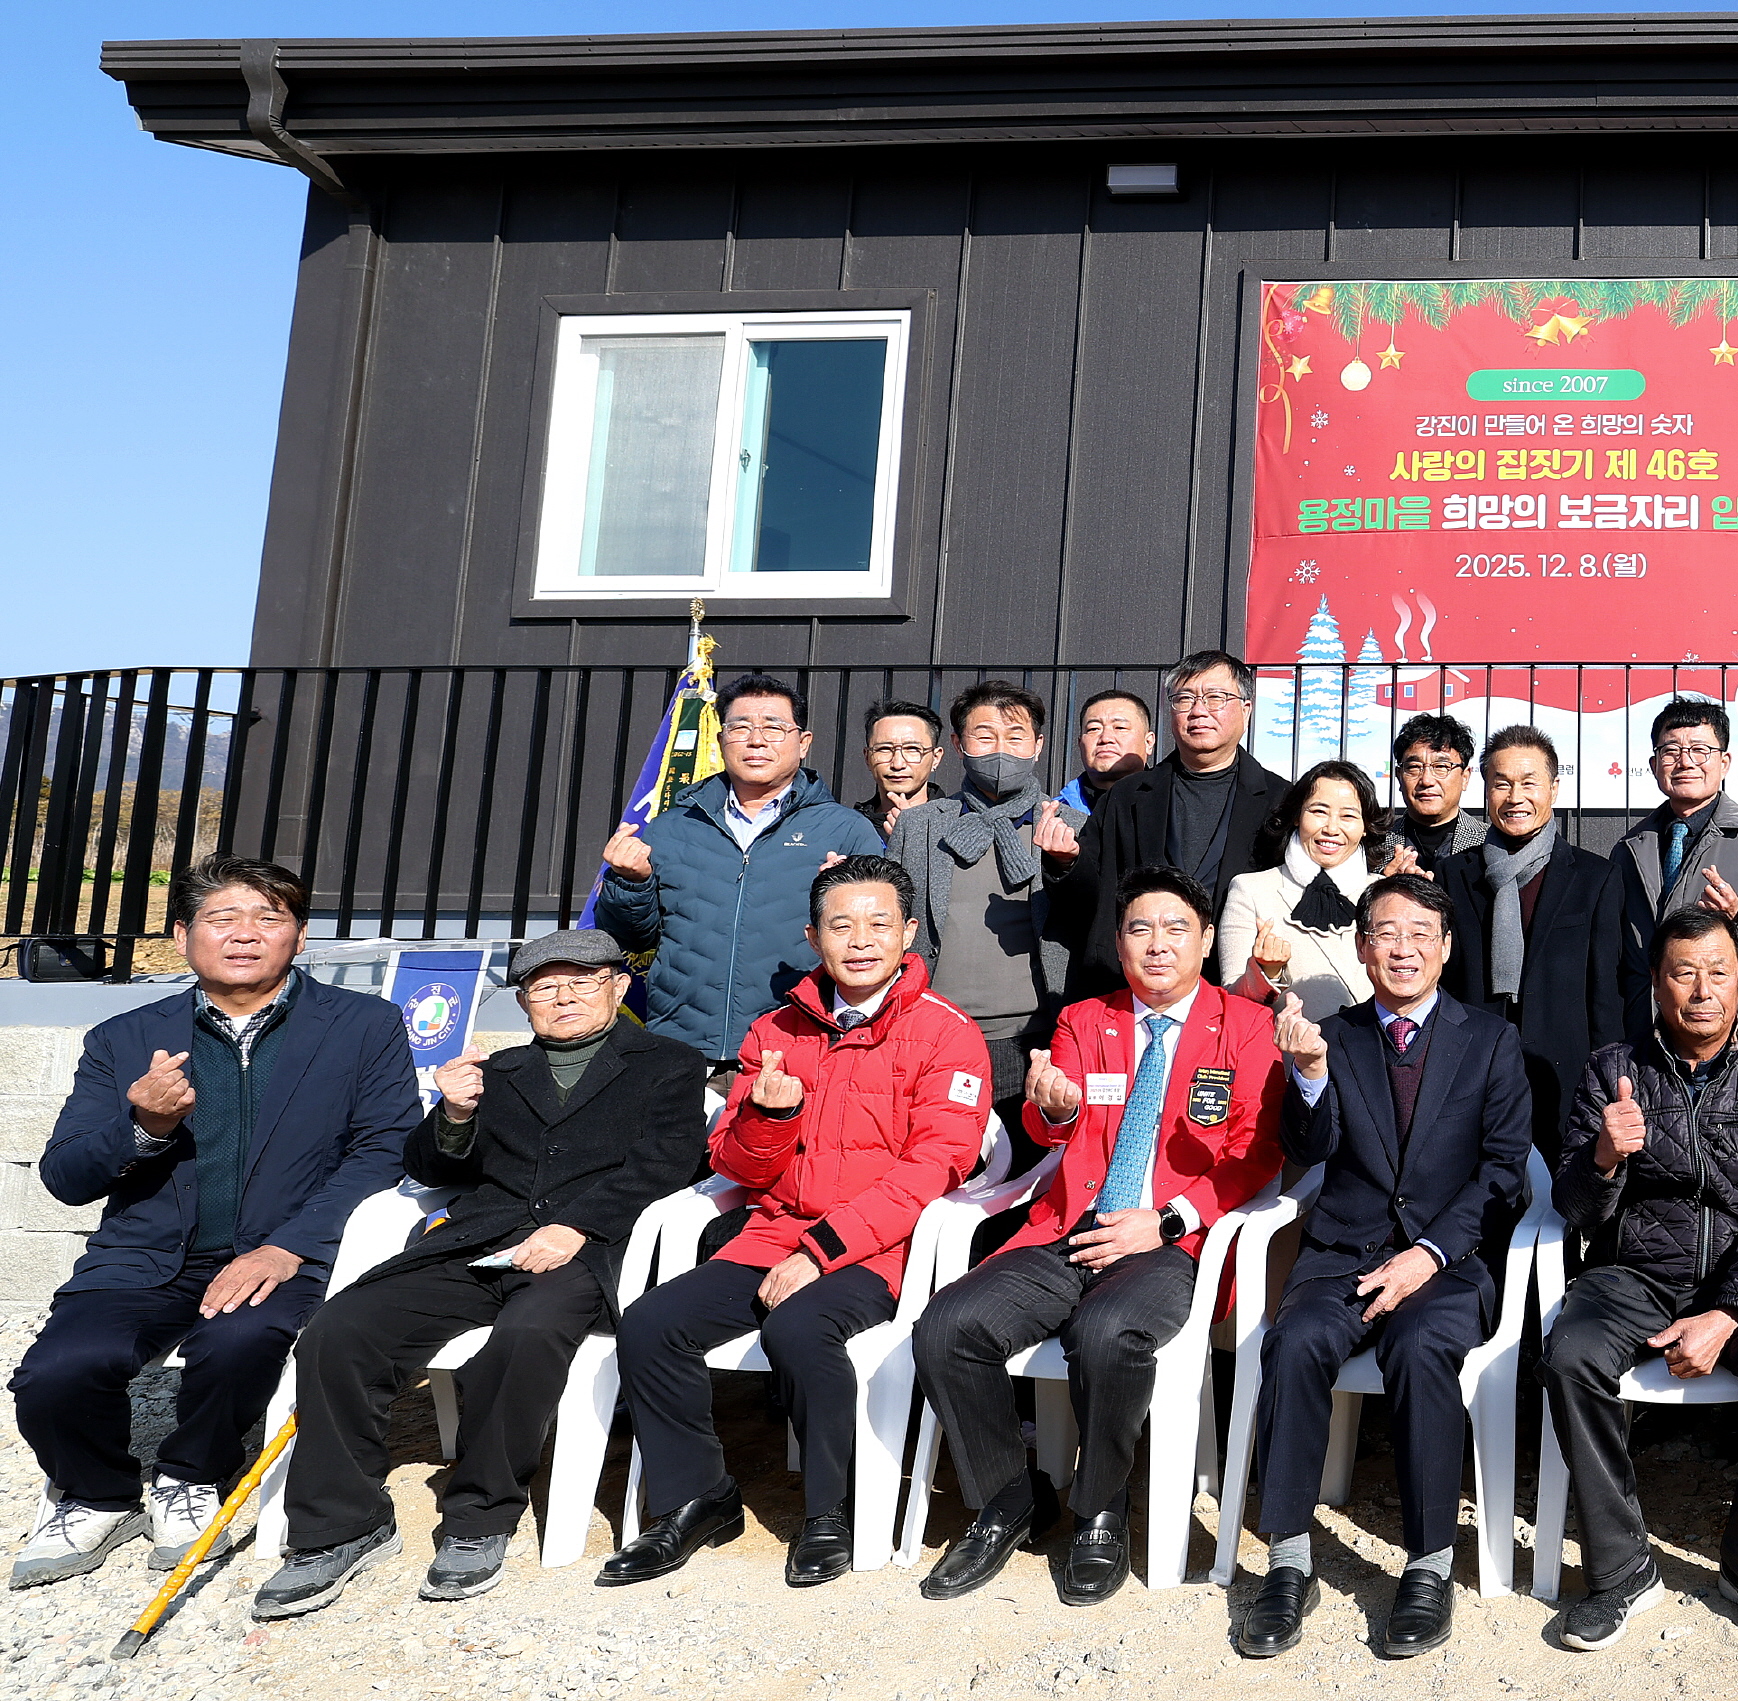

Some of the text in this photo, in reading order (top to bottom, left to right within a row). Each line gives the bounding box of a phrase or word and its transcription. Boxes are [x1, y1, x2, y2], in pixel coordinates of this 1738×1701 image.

[1502, 375, 1609, 395] since 2007
[1415, 413, 1694, 437] 강진이 만들어 온 희망의 숫자
[1389, 448, 1720, 482] 사랑의 집짓기 제 46호
[1297, 495, 1432, 533] 용정마을
[1441, 493, 1547, 530] 희망의
[1557, 493, 1700, 530] 보금자리
[1455, 552, 1648, 579] 2025. 12. 8.(월)
[407, 984, 458, 1010] 강진군
[405, 1019, 455, 1046] GANG JIN CITY
[1202, 1097, 1216, 1105] FOR
